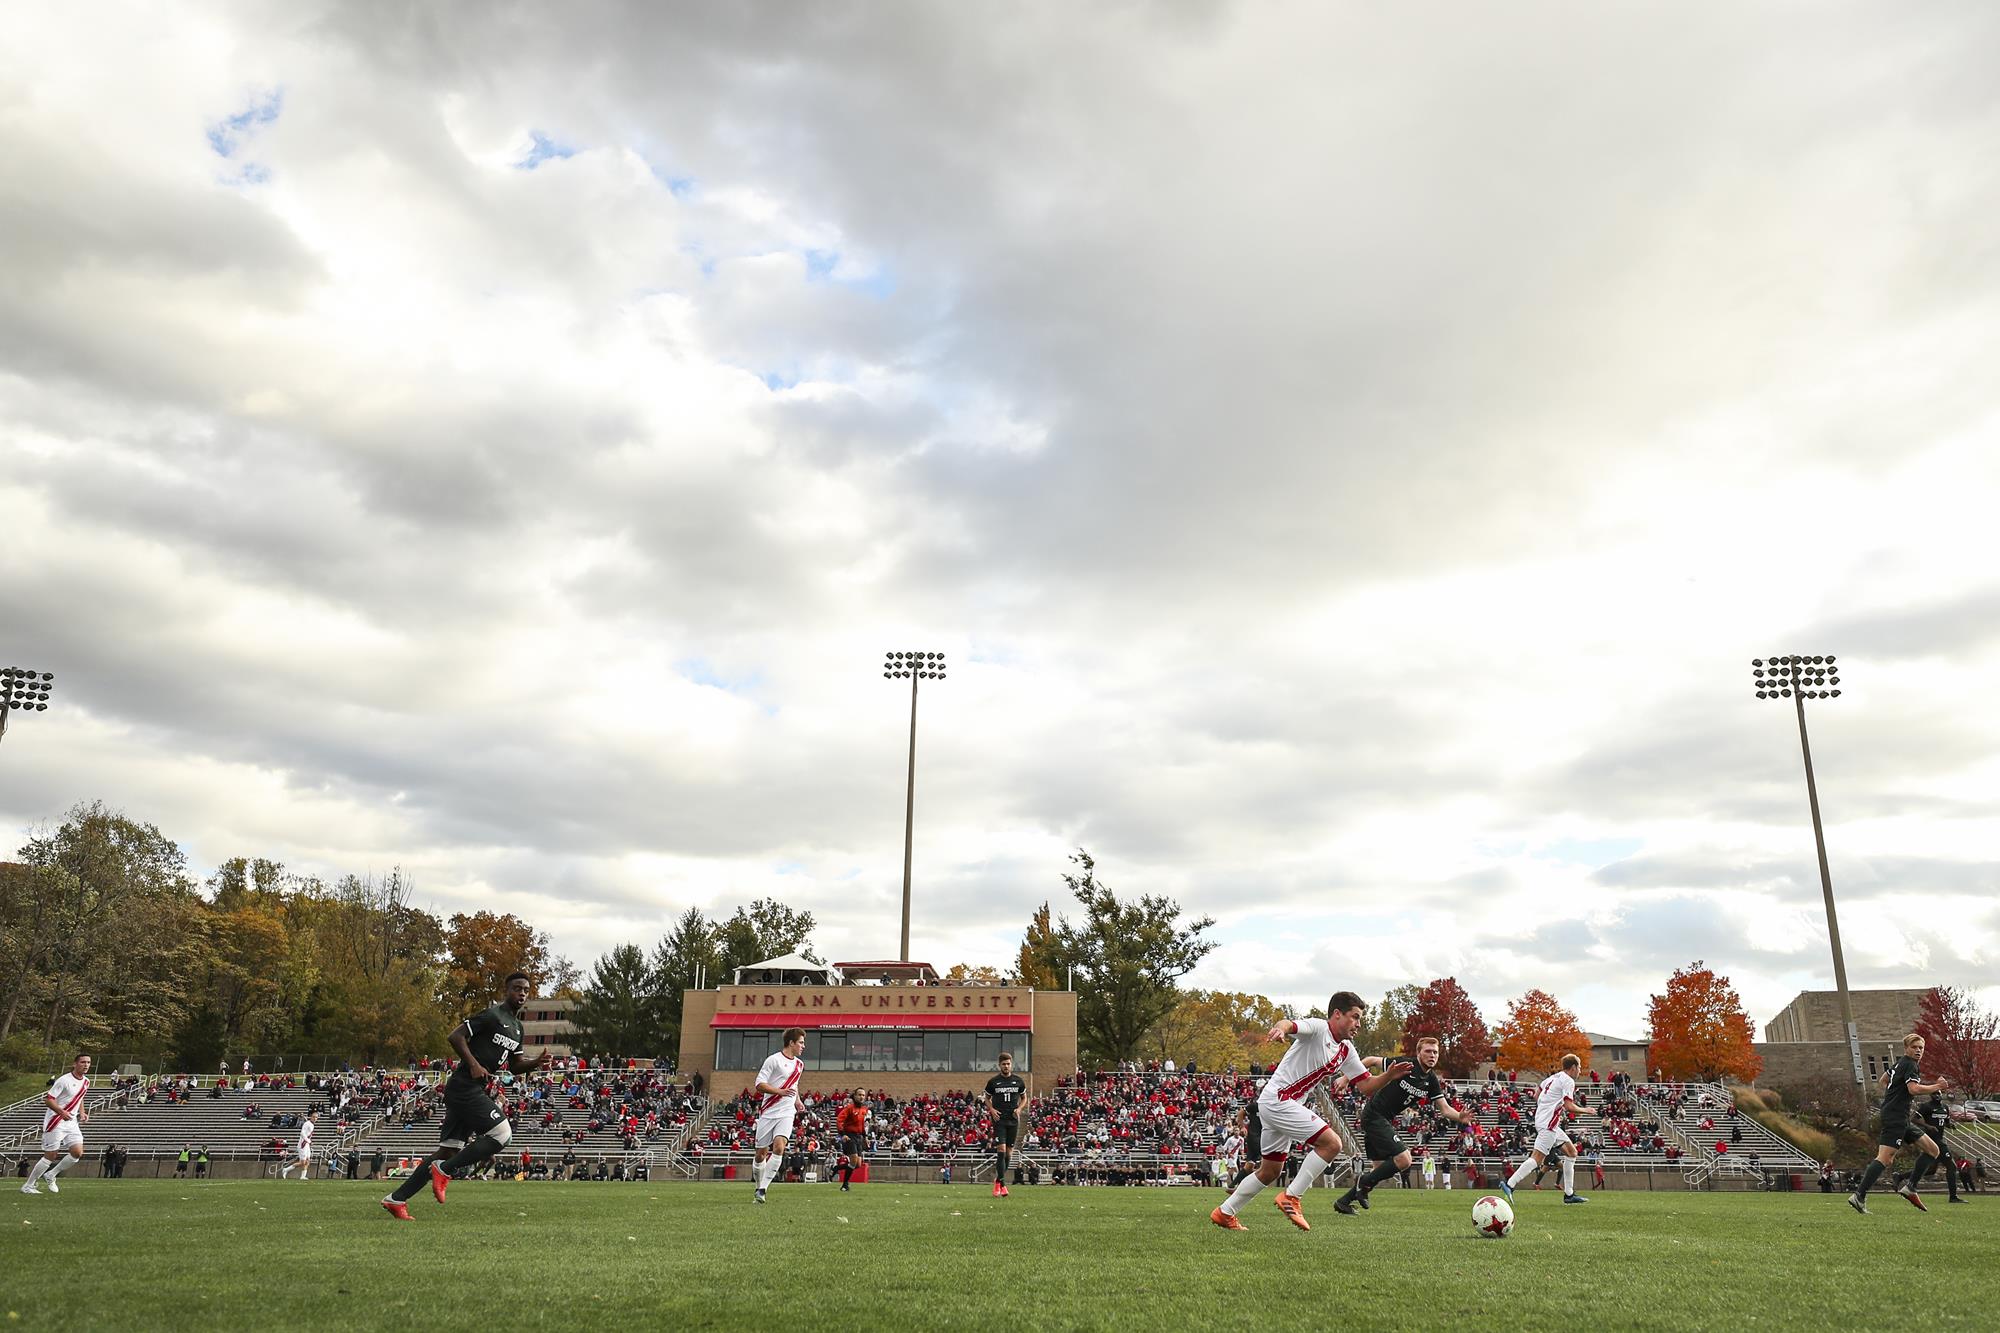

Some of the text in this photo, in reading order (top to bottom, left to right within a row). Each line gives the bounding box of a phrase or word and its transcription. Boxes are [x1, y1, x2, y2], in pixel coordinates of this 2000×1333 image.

[730, 995, 1017, 1008] INDIANA UNIVERSITY
[498, 1049, 508, 1065] 9
[1544, 1079, 1554, 1094] 4
[1003, 1093, 1010, 1102] 11
[1403, 1095, 1414, 1105] 5
